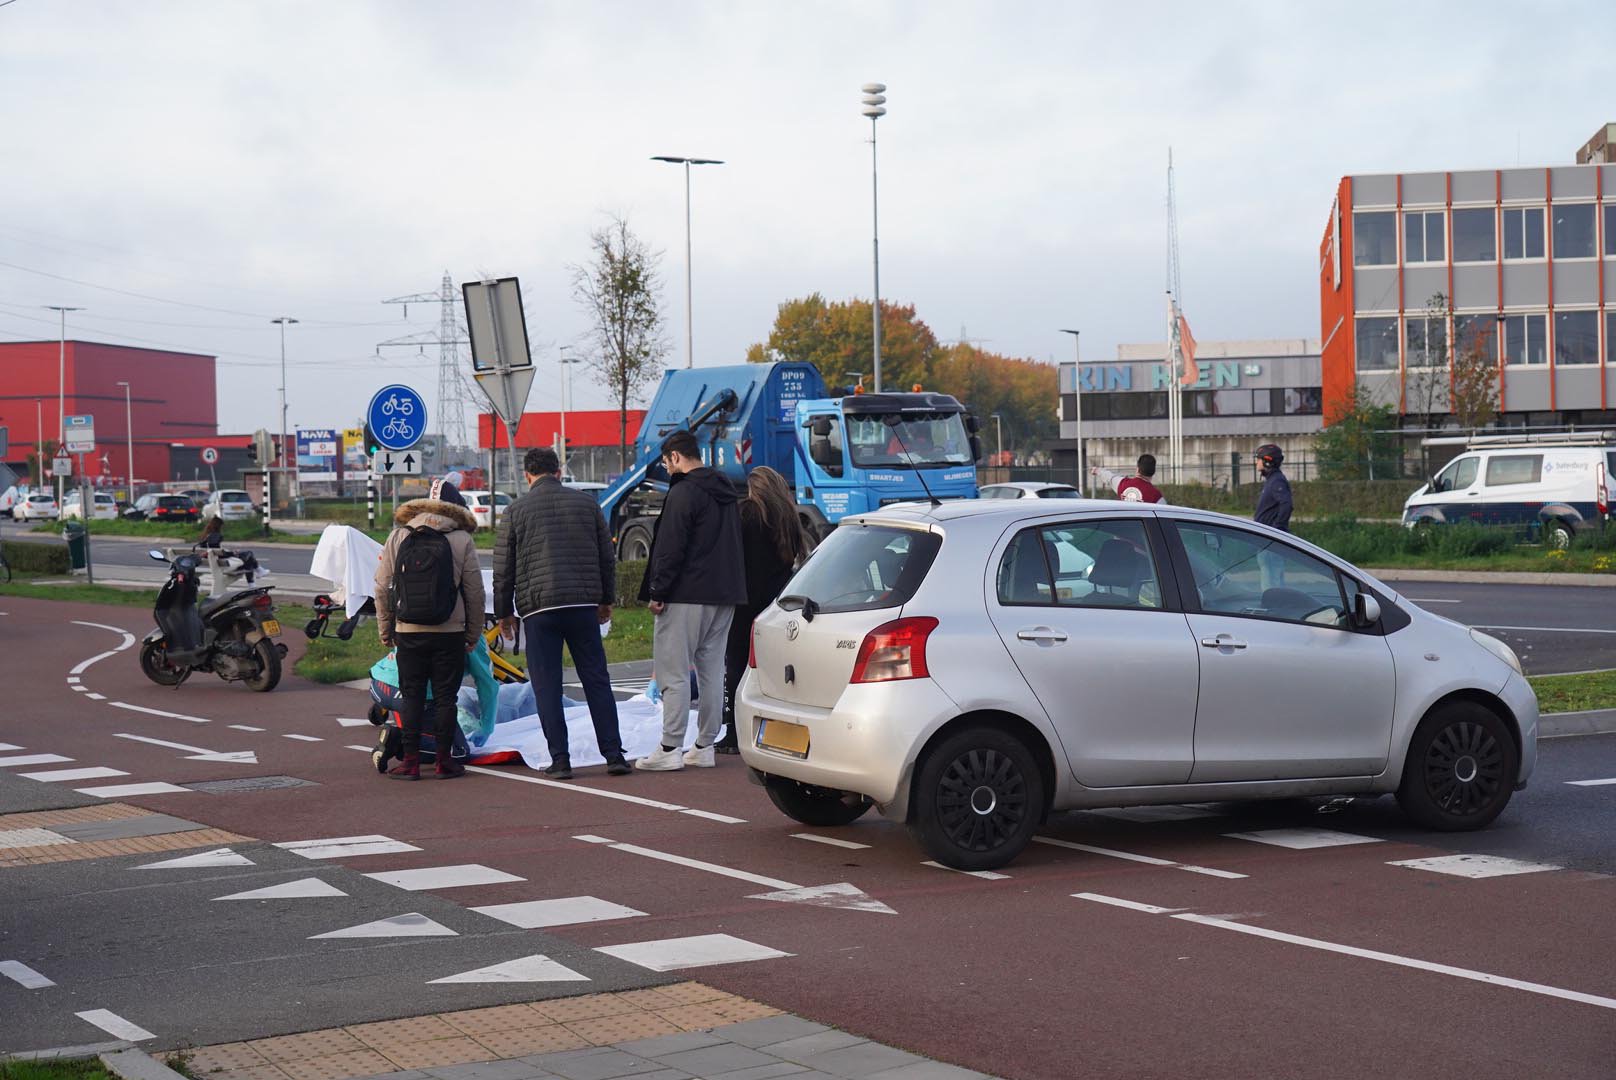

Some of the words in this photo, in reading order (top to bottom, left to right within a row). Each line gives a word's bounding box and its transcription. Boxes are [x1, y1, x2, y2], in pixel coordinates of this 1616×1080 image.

[1071, 366, 1131, 391] KIN
[869, 474, 904, 482] SWARTJES
[836, 640, 857, 649] YARIS
